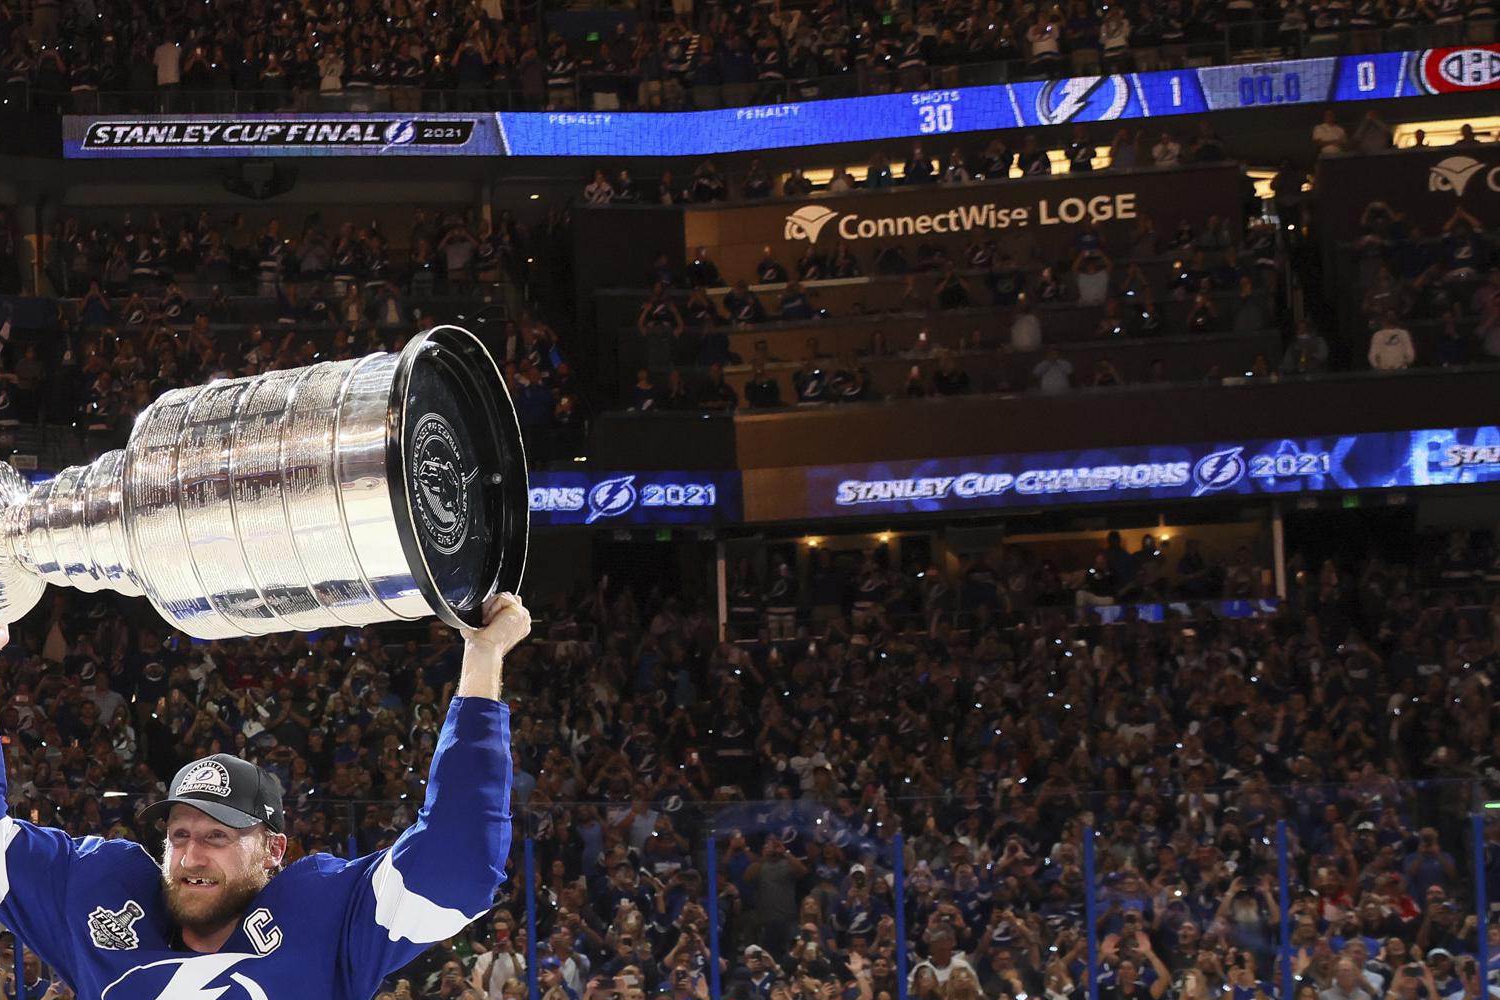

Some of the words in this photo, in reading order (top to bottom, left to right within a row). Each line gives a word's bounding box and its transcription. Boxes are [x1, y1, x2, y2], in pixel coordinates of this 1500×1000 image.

[1169, 76, 1181, 107] 1
[1357, 61, 1376, 92] 0
[911, 90, 960, 105] SHOTS
[549, 114, 612, 126] PENALTY
[736, 105, 800, 121] PENALTY
[918, 103, 954, 133] 30
[93, 125, 224, 144] STANLEY
[222, 124, 279, 143] CUP
[285, 122, 381, 143] FINAL
[423, 127, 462, 139] 2021
[838, 203, 1030, 240] ConnectWise
[1038, 193, 1137, 225] LOGE
[835, 477, 956, 505] STANLEY
[952, 473, 1015, 498] CUP
[1014, 461, 1191, 495] CHAMPIONS
[1248, 452, 1330, 478] 2021
[640, 482, 717, 506] 2021
[94, 912, 135, 947] FINAL
[243, 908, 283, 956] C
